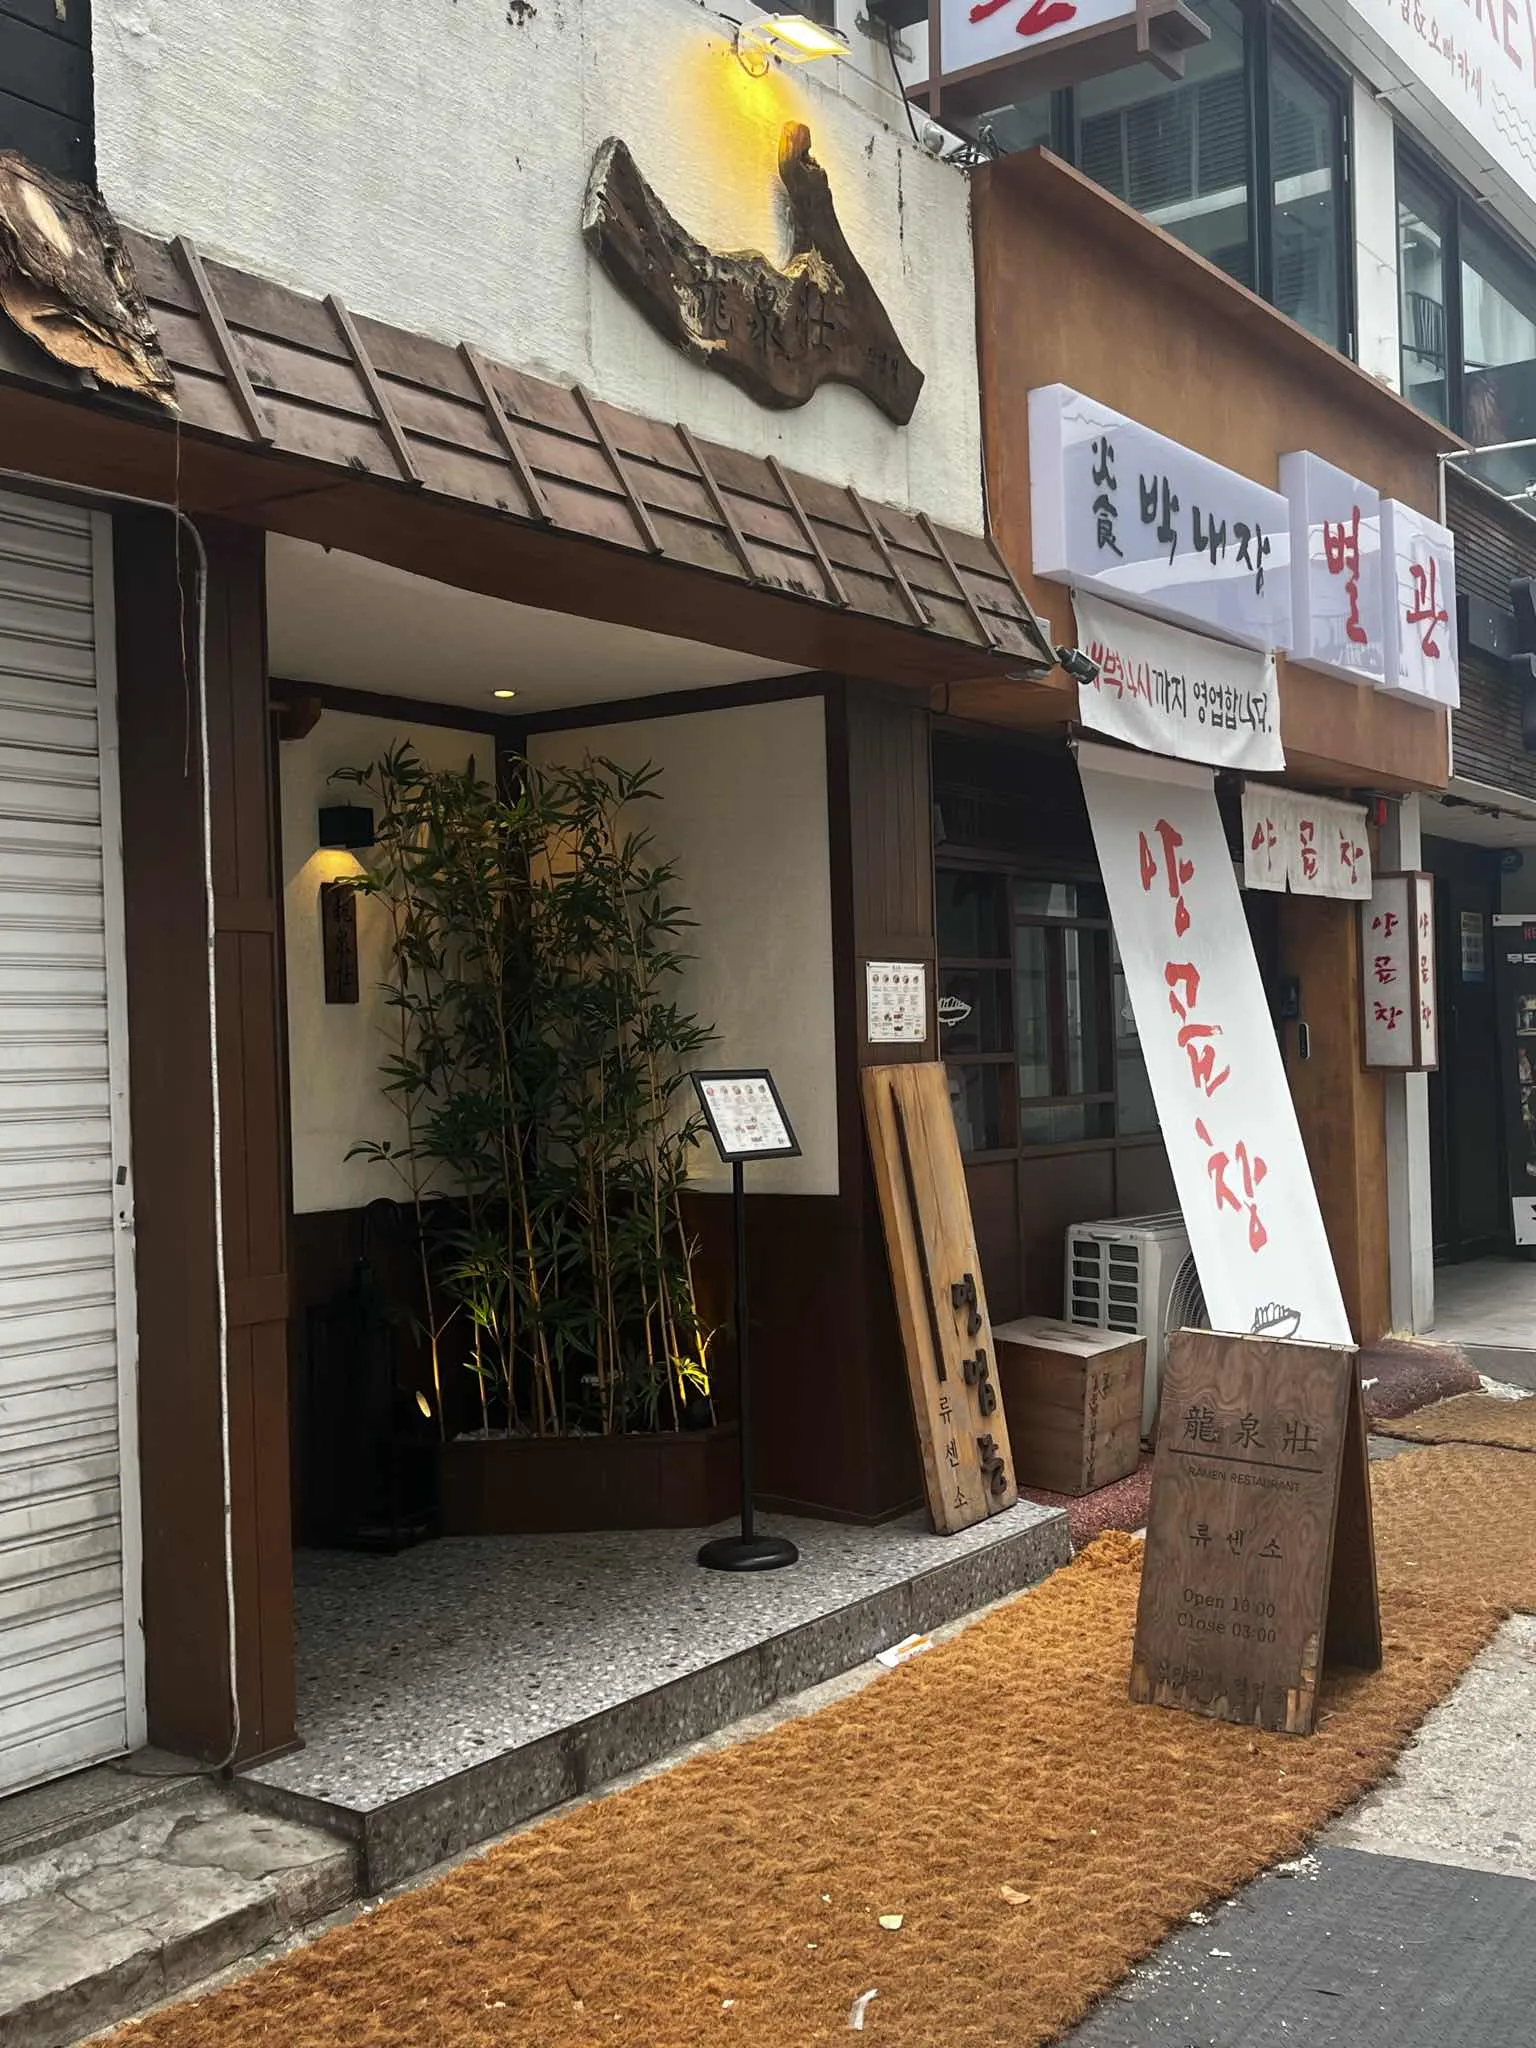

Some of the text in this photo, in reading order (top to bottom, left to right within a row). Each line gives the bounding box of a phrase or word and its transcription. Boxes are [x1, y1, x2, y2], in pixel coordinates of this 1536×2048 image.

[1193, 680, 1272, 733] 영업합니다.
[1371, 911, 1404, 1030] 양곱창
[1139, 819, 1268, 1253] 양곱창
[1188, 1466, 1300, 1492] RAMEN RESTAURANT
[1190, 1524, 1283, 1559] 류센소
[1183, 1588, 1225, 1609] Open
[1177, 1612, 1226, 1634] Close
